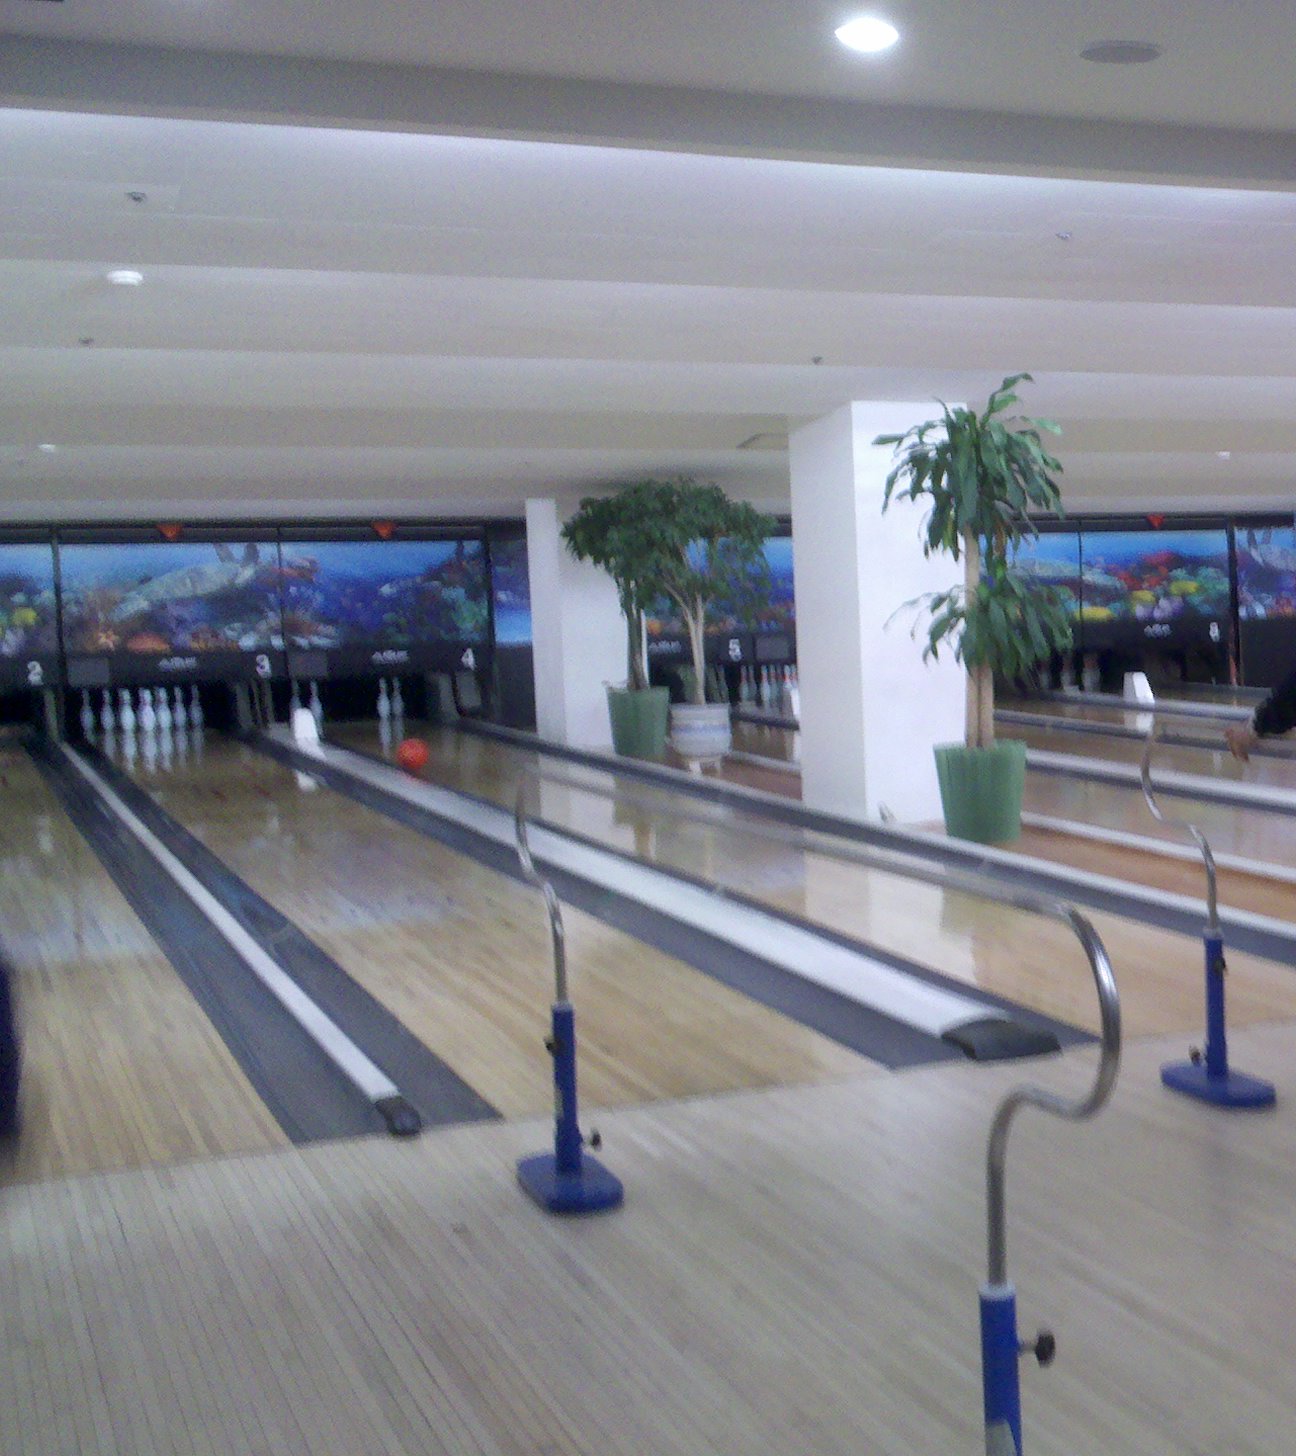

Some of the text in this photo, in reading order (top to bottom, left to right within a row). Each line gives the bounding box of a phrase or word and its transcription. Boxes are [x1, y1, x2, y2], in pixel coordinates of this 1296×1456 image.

[461, 647, 476, 670] 4
[728, 638, 742, 662] 5
[27, 661, 43, 686] 2
[256, 654, 272, 678] 3
